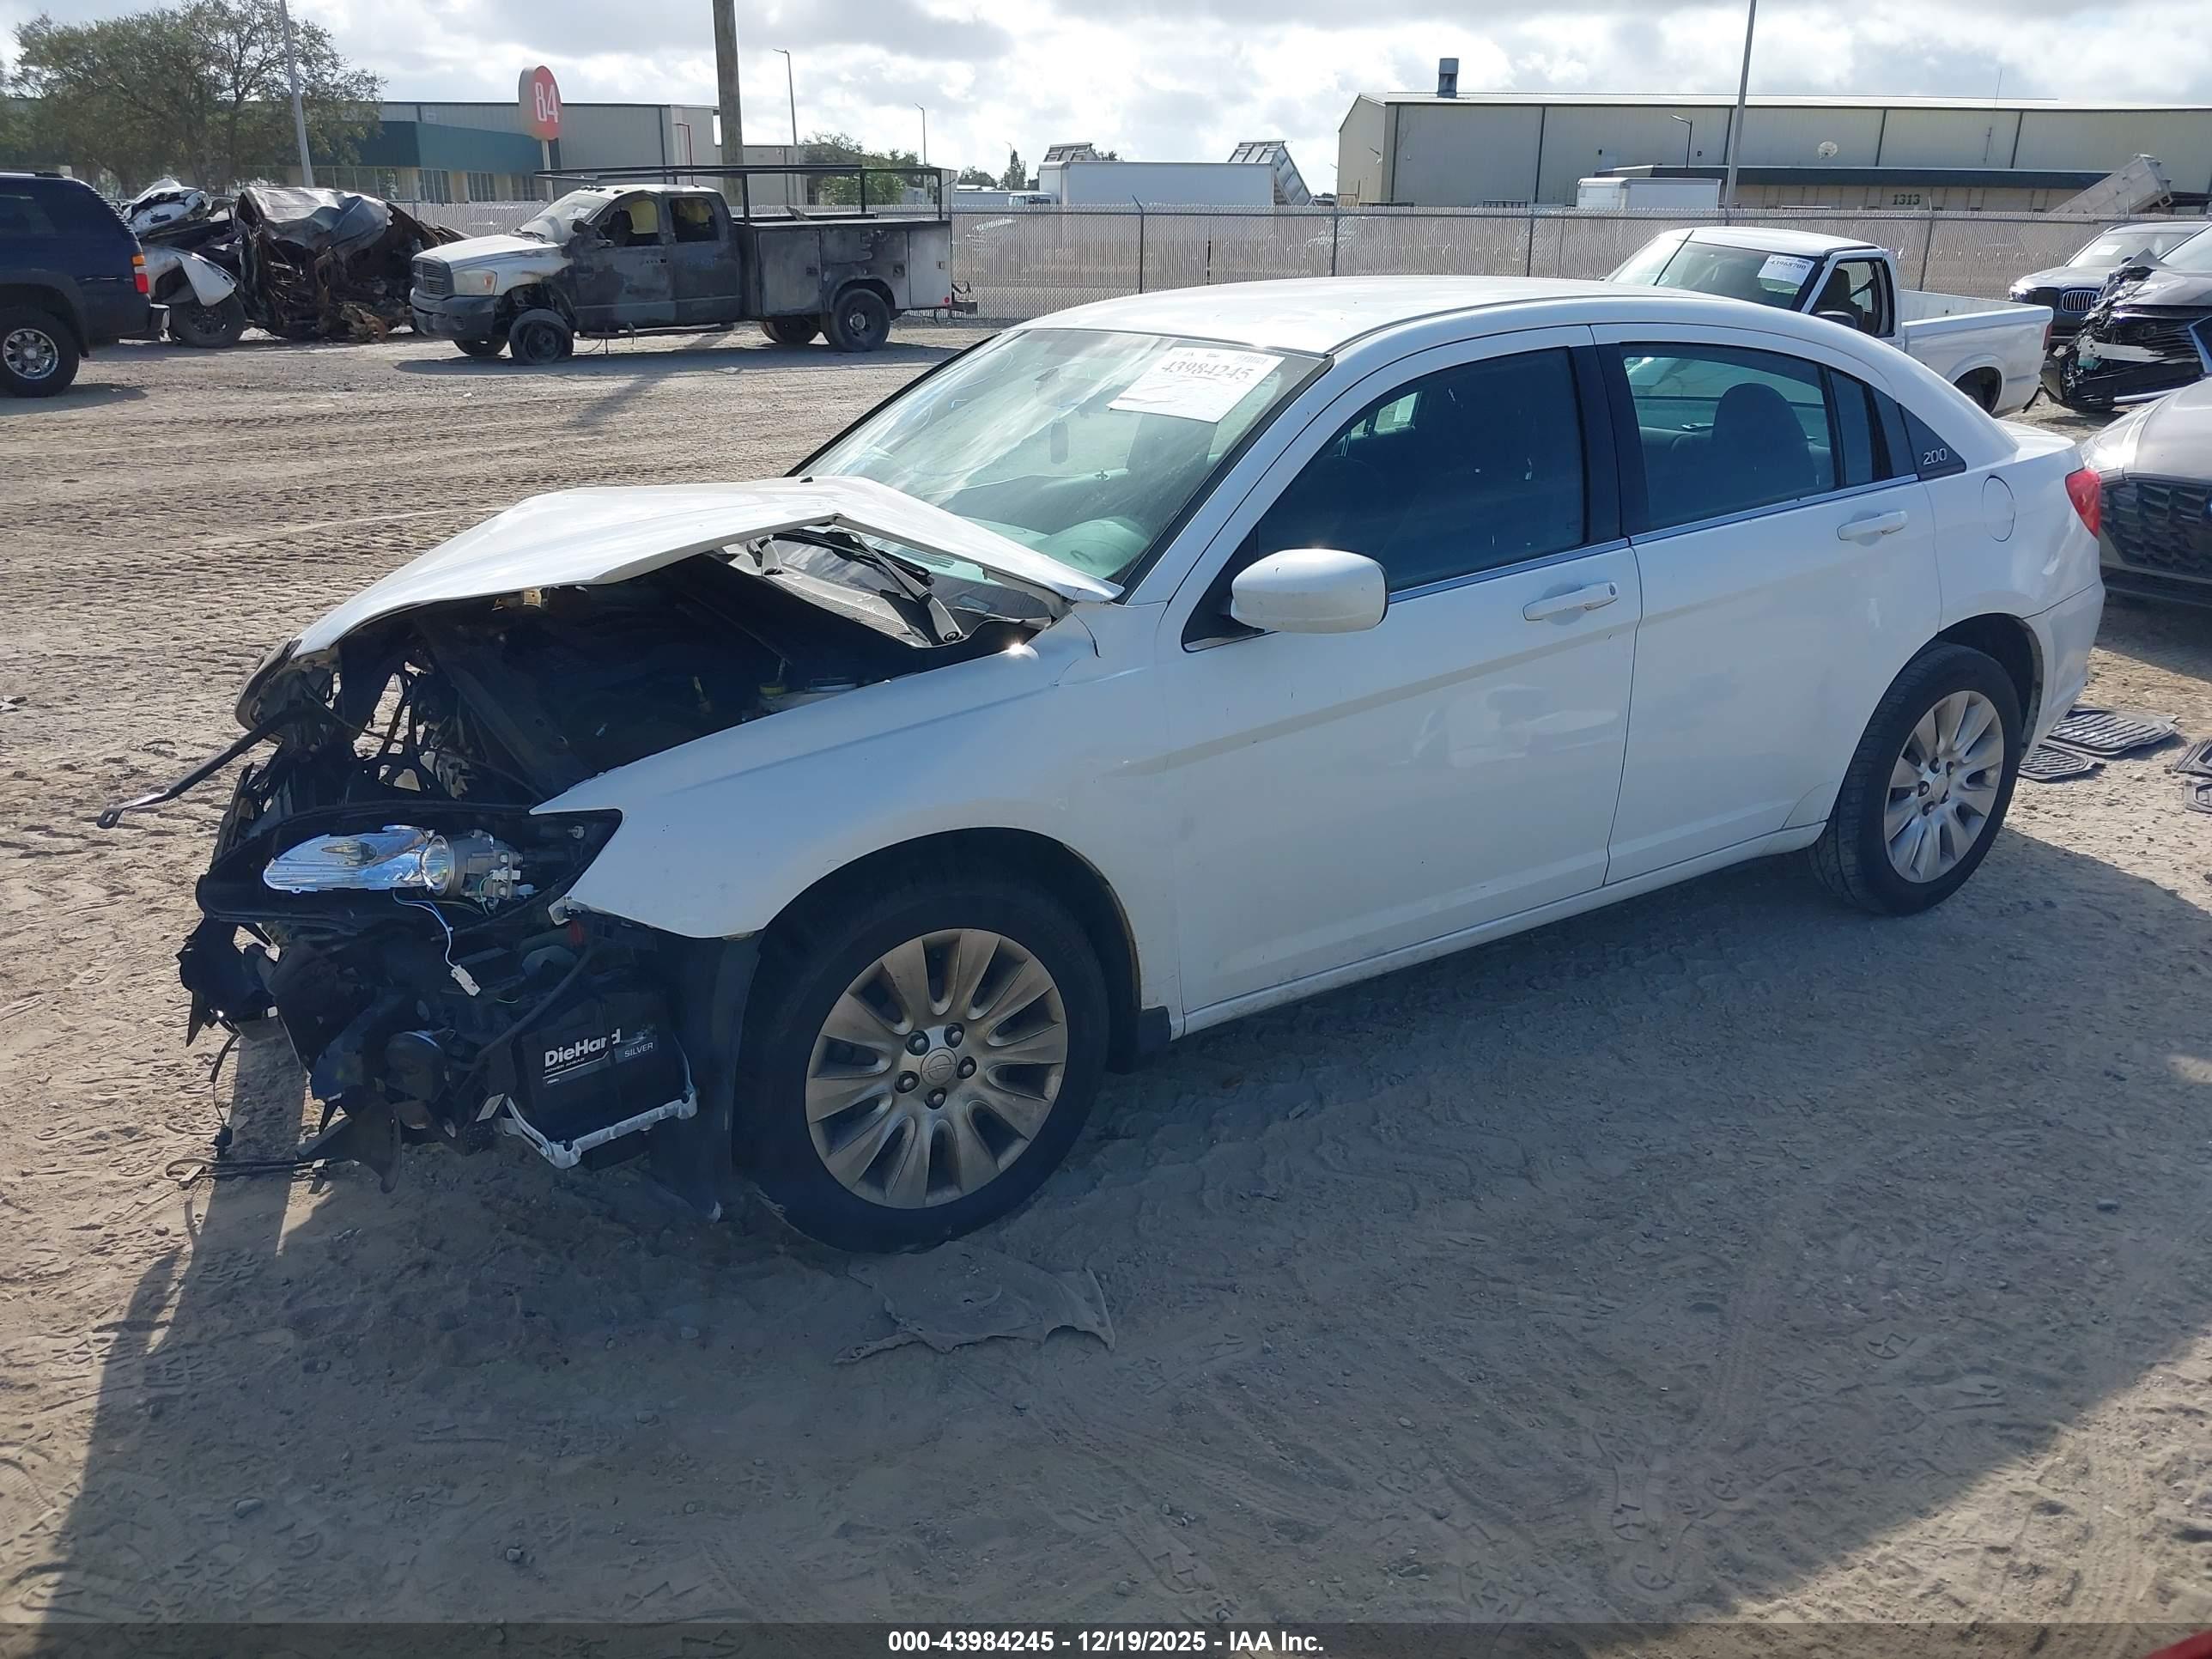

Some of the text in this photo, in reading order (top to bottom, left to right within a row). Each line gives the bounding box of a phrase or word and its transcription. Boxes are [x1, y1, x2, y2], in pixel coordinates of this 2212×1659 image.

[535, 82, 558, 124] 84
[1892, 193, 1920, 205] 1313
[1162, 361, 1255, 380] 43984245
[1923, 448, 1948, 465] 200
[544, 1028, 621, 1067] DieHard
[624, 1042, 654, 1058] SILVER
